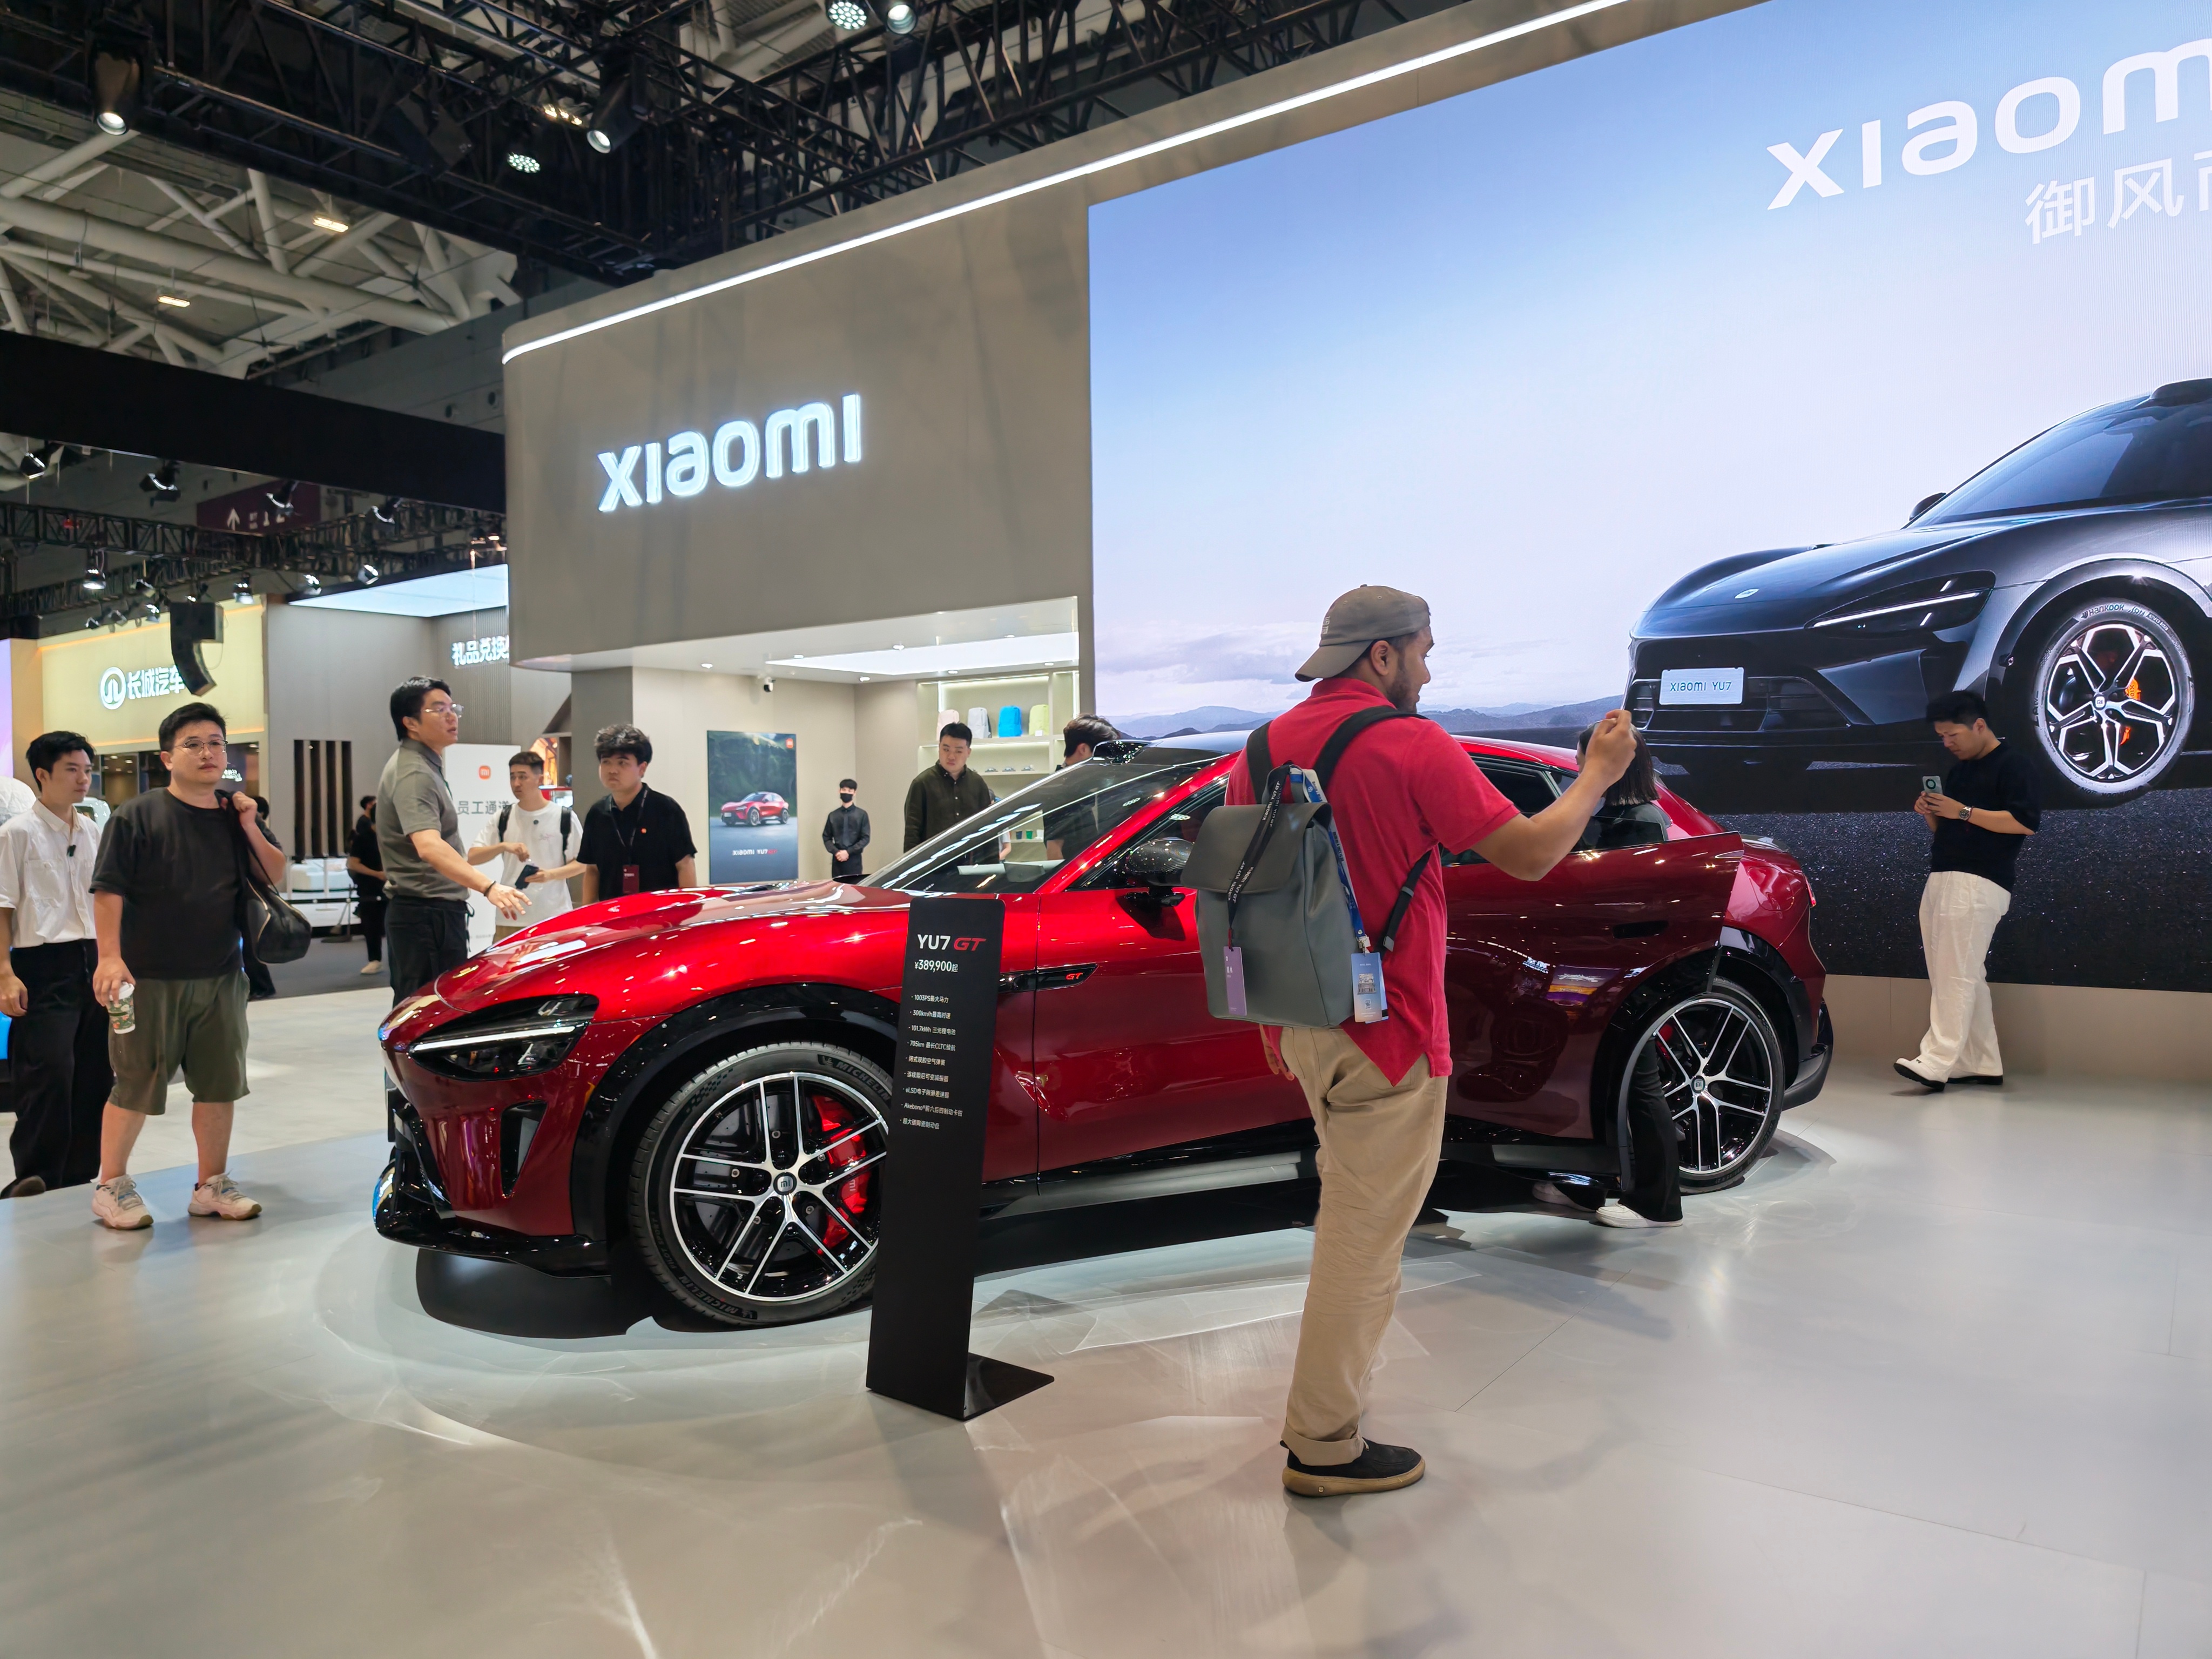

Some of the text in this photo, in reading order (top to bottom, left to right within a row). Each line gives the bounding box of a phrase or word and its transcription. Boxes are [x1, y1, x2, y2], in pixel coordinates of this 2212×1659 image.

[597, 393, 861, 512] xiaomi
[451, 635, 509, 666] 礼品兑换
[1712, 682, 1732, 691] YU7
[917, 934, 987, 951] YU7 GT
[835, 1060, 891, 1102] MICHELIN
[678, 1274, 739, 1314] MICHELIN
